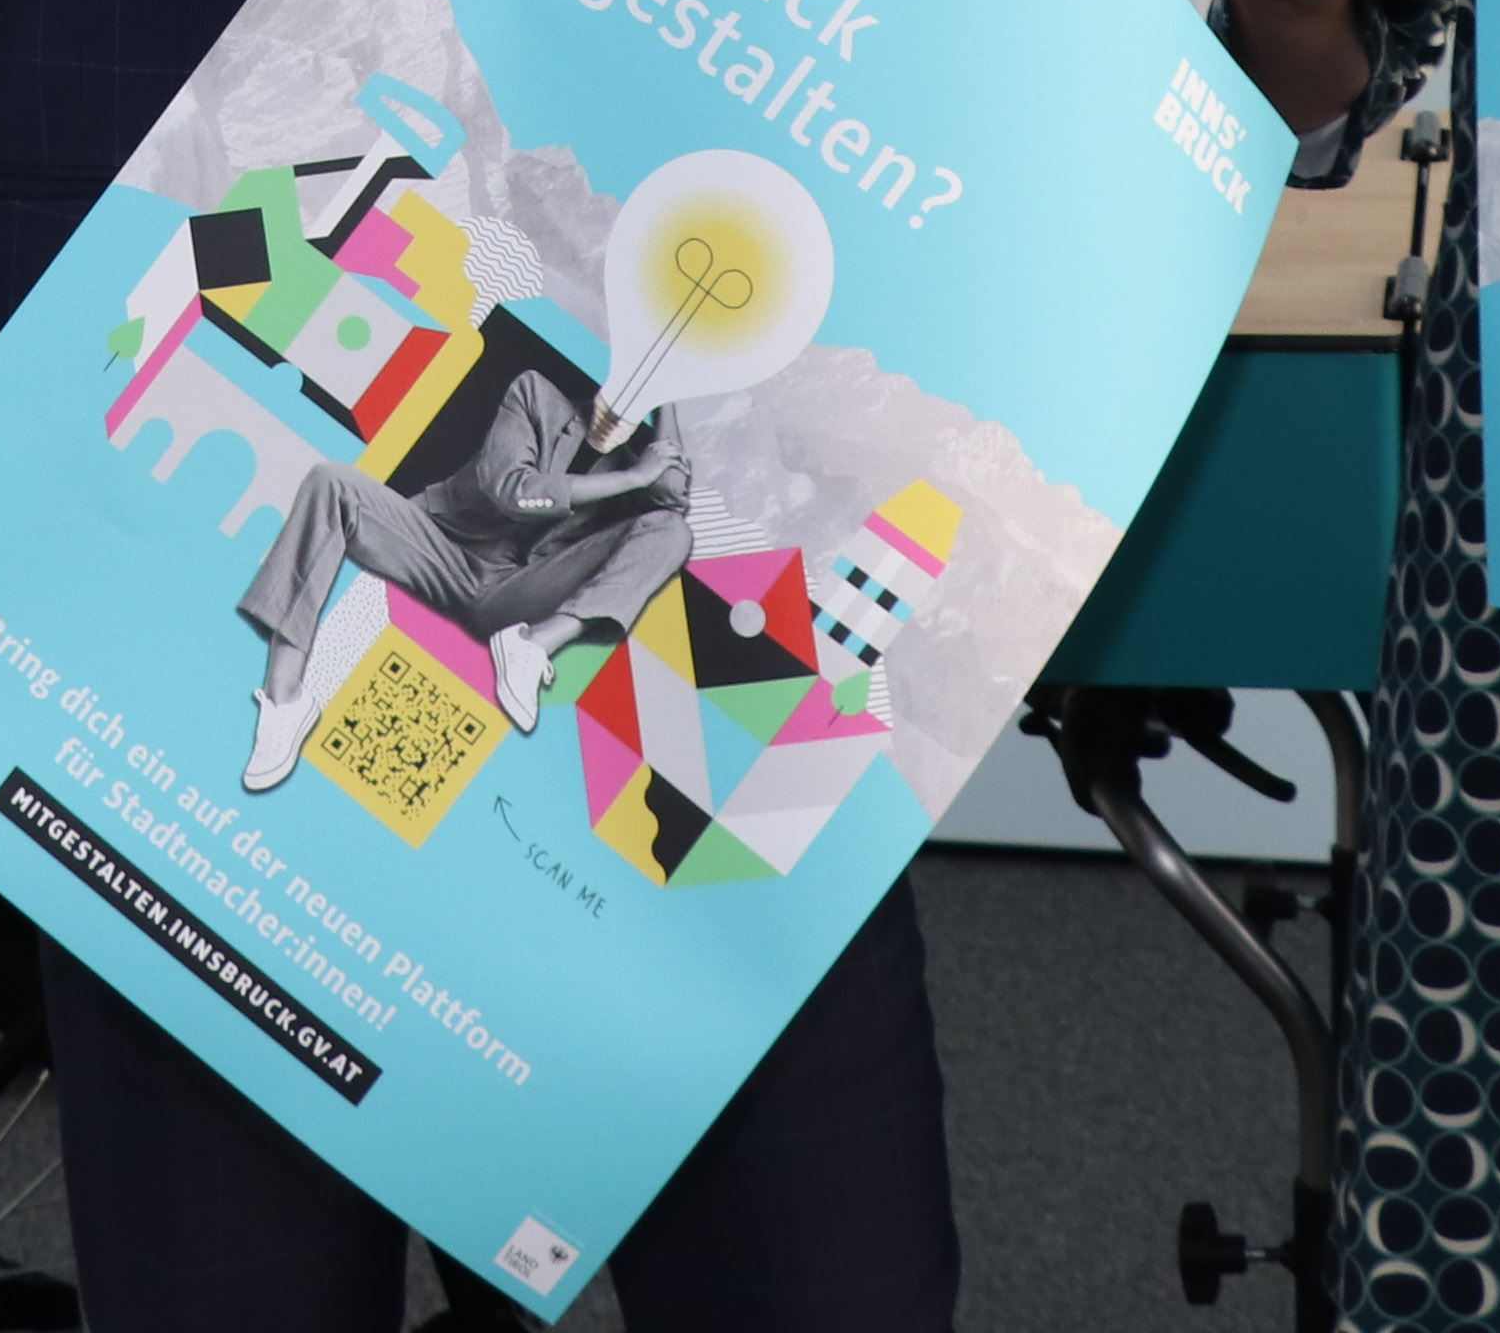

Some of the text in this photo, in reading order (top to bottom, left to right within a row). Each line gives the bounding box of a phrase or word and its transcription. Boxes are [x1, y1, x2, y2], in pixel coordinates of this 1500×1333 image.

[1153, 90, 1252, 215] BRUCK
[1171, 57, 1248, 150] INNS'
[10, 786, 363, 1084] MITGESTALTEN.INNSBRUCK.GV.AT
[54, 737, 398, 1033] für Stadtmacher:innen!
[60, 685, 125, 749] dich
[126, 744, 176, 792] ein
[177, 786, 241, 835] auf
[230, 829, 287, 881] der
[285, 874, 382, 964] neuen
[382, 951, 533, 1086] Plattform
[525, 843, 607, 919] SCAN ME
